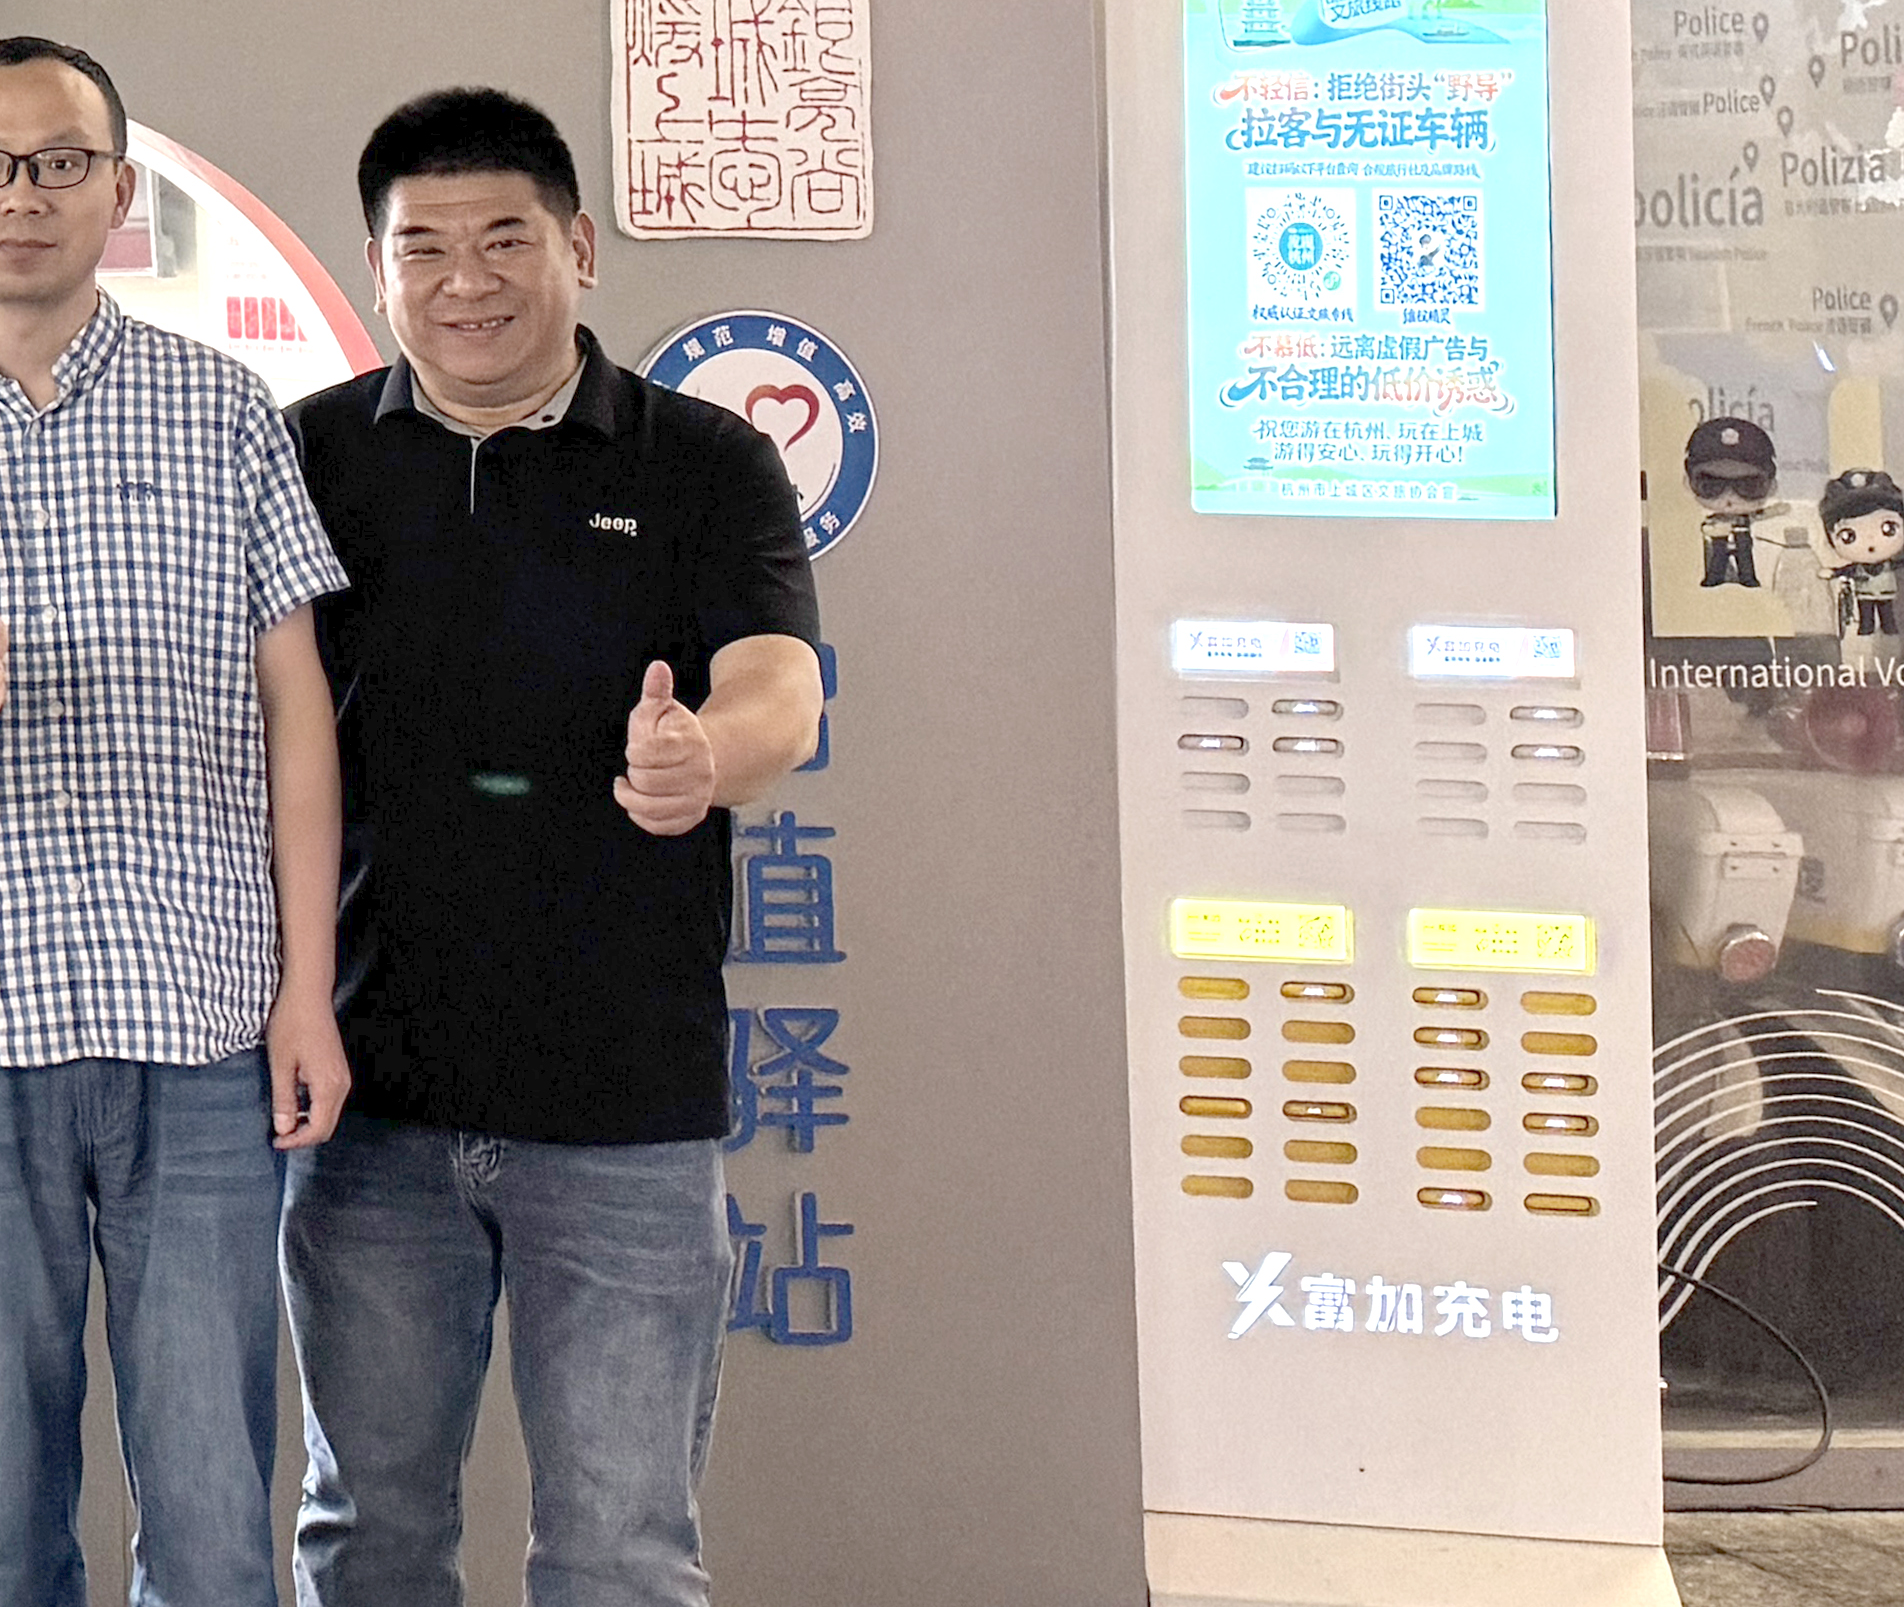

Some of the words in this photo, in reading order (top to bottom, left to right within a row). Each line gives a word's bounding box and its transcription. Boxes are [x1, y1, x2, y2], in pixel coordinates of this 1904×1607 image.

[1674, 6, 1745, 38] Police
[1703, 86, 1761, 116] Police
[1242, 106, 1490, 150] 拉客与无证车辆
[1811, 285, 1873, 312] Police
[1228, 362, 1500, 411] 不合理的低价诱惑
[588, 512, 638, 537] Jeep
[1648, 655, 1867, 690] International
[1300, 1272, 1560, 1344] 富加充电
